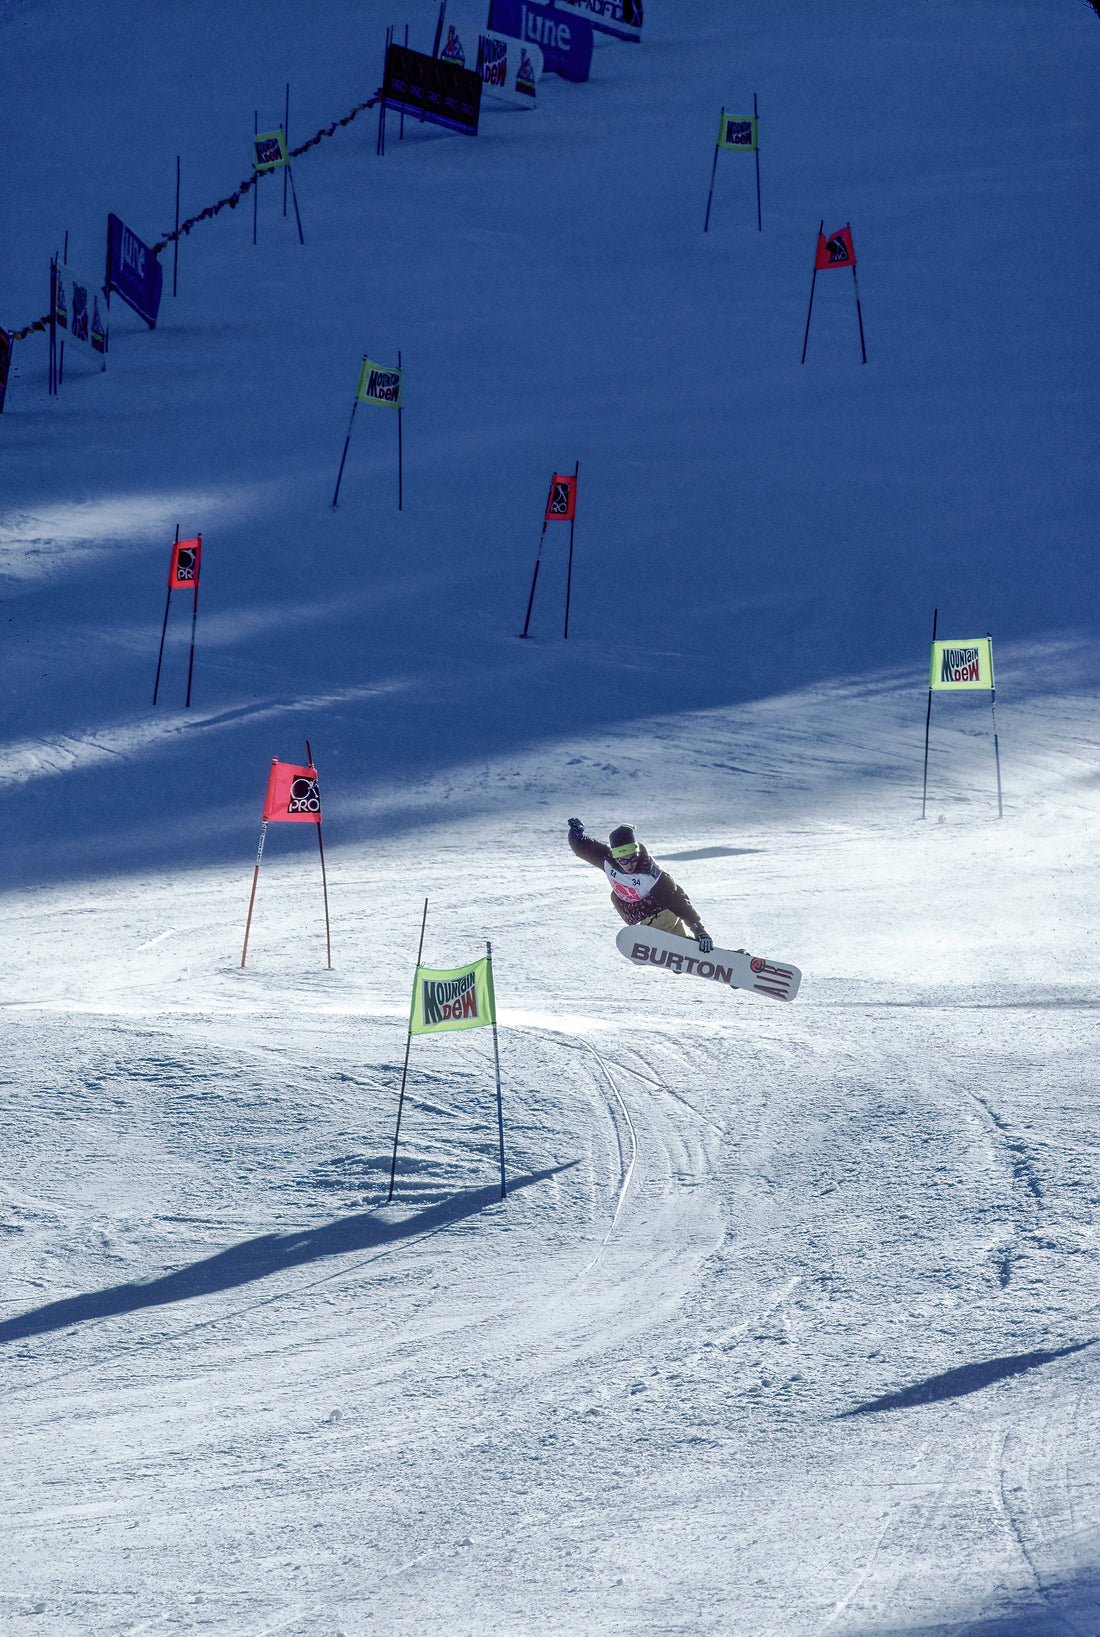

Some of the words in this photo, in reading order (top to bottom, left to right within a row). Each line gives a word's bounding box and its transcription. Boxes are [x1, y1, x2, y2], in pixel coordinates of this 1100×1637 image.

[289, 799, 320, 813] PRO
[631, 878, 641, 887] 34
[631, 943, 733, 983] BURTON
